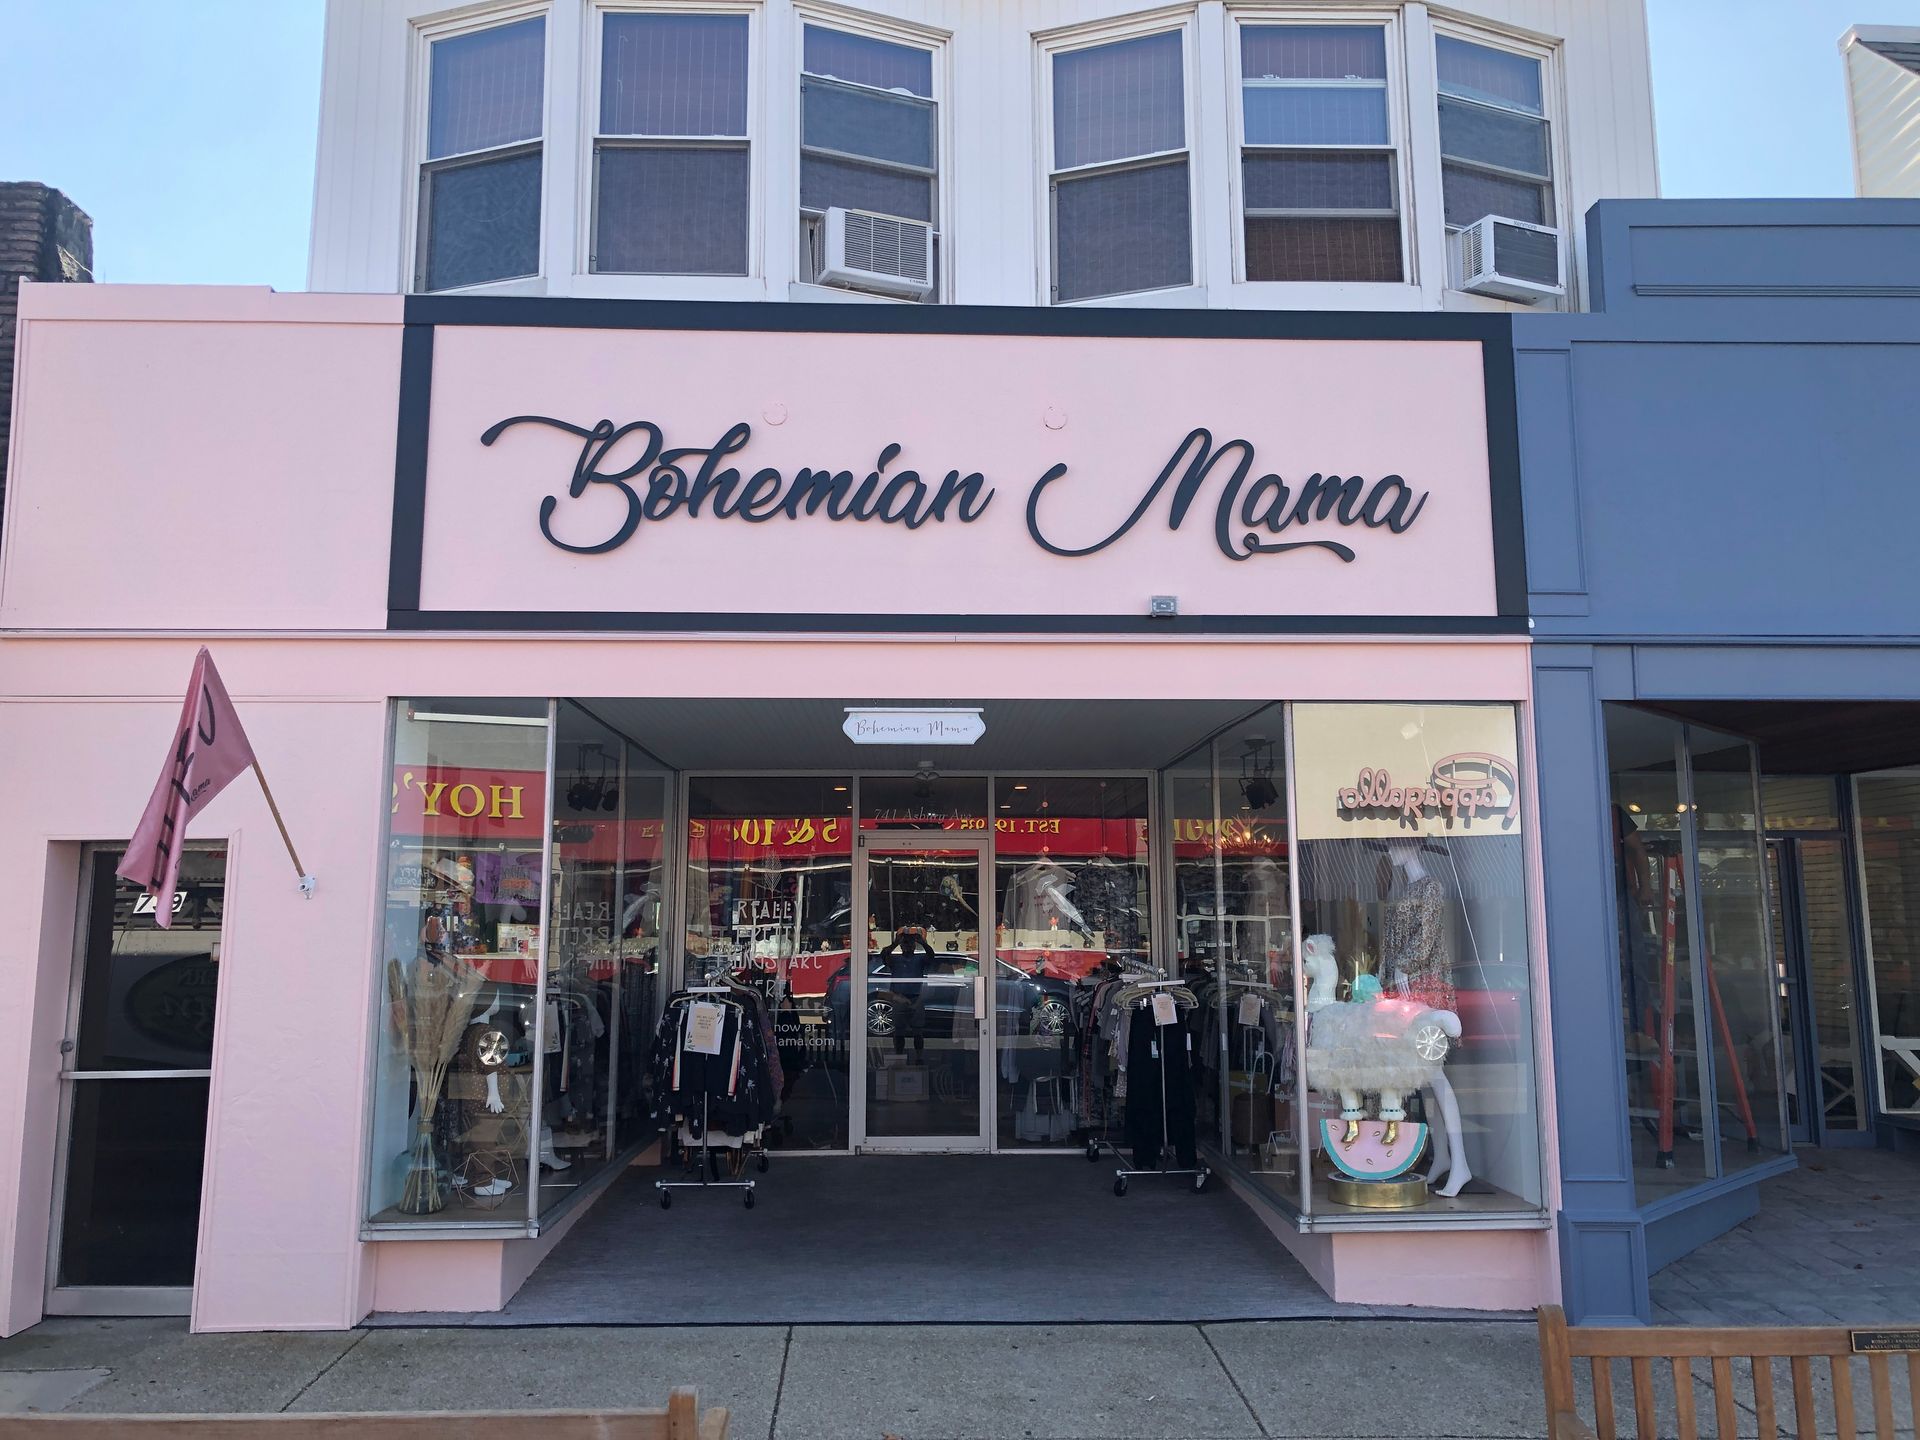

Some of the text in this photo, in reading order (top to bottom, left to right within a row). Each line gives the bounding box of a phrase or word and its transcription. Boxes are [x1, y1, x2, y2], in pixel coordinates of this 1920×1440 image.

[481, 413, 1430, 562] Bohemian Mama
[856, 719, 970, 736] Bohemian Mama
[874, 808, 897, 821] 741
[136, 893, 183, 912] 79
[737, 900, 802, 920] REALLY
[774, 1023, 816, 1032] now at
[774, 1035, 835, 1047] ama.com
